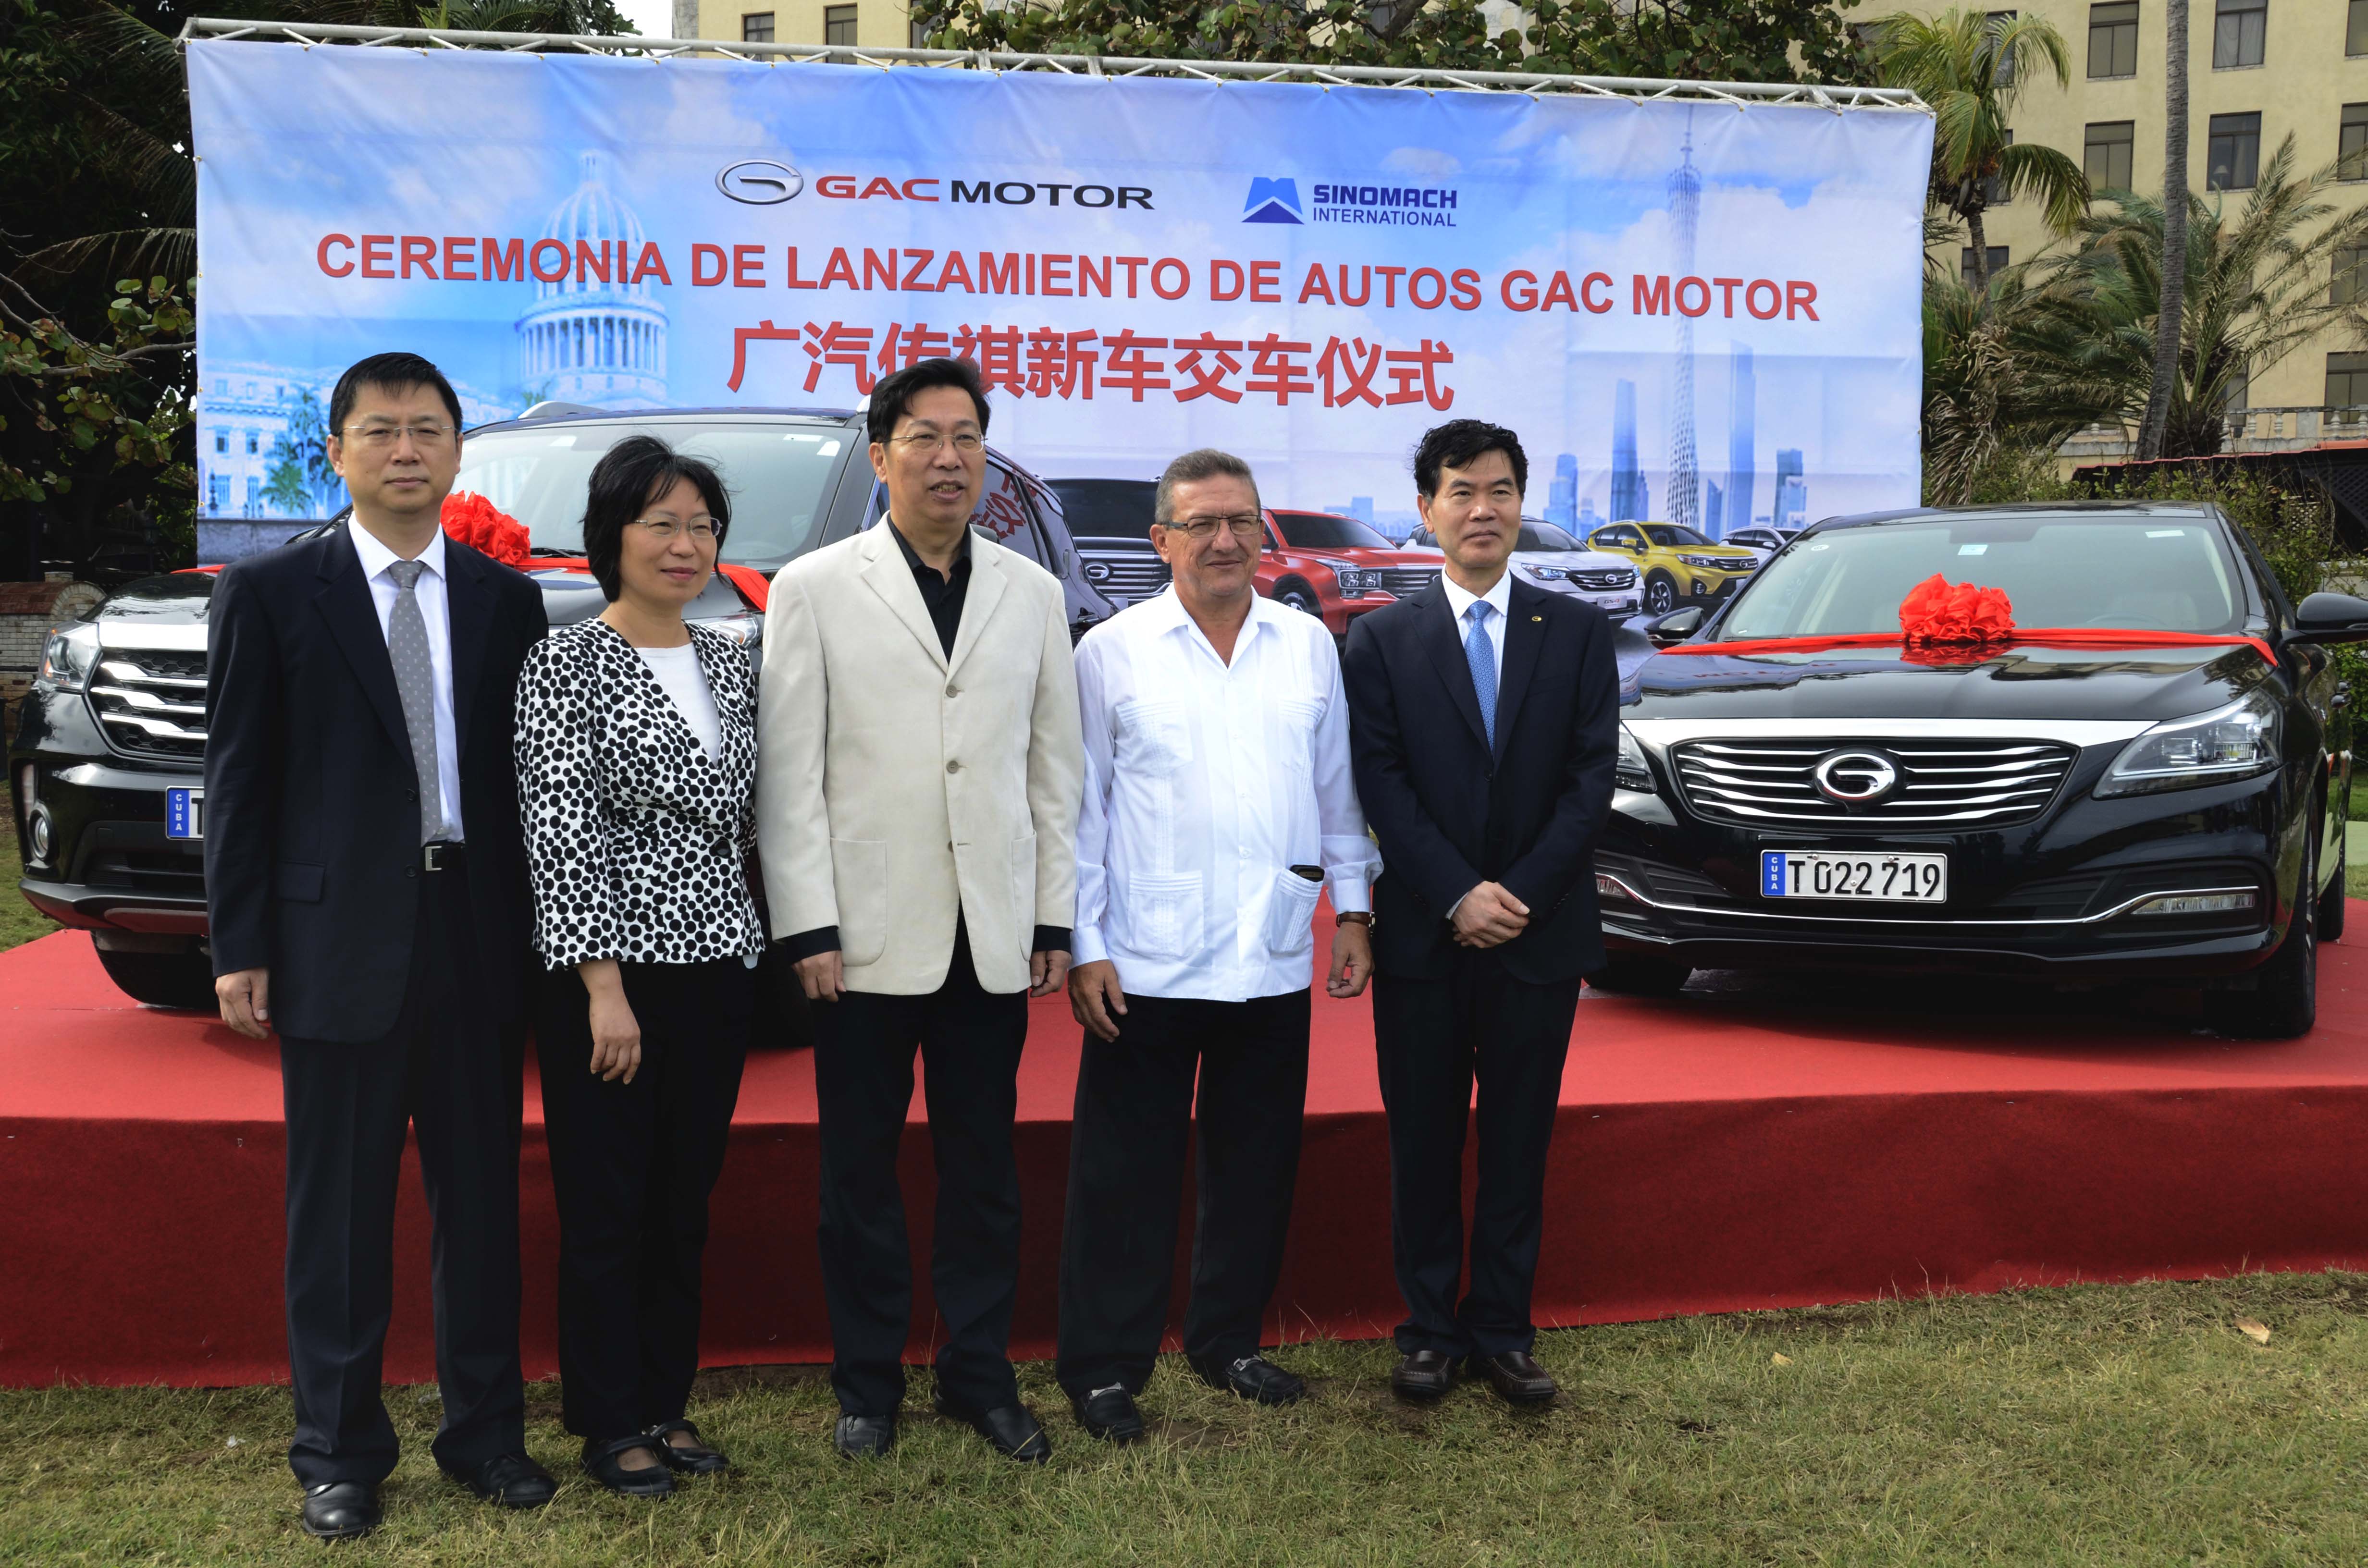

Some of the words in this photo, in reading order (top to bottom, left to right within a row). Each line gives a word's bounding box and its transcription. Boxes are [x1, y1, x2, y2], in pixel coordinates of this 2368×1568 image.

[815, 175, 940, 202] GAC
[951, 181, 1155, 210] MOTOR
[1313, 184, 1457, 209] SINOMACH
[1313, 208, 1457, 227] INTERNATIONAL
[317, 233, 672, 285] CEREMONIA
[691, 243, 766, 288] DE
[787, 246, 1191, 300] LANZAMIENTO
[1210, 259, 1282, 303] DE
[1298, 263, 1482, 310] AUTOS
[1500, 270, 1614, 314] GAC
[1633, 274, 1820, 321] MOTOR
